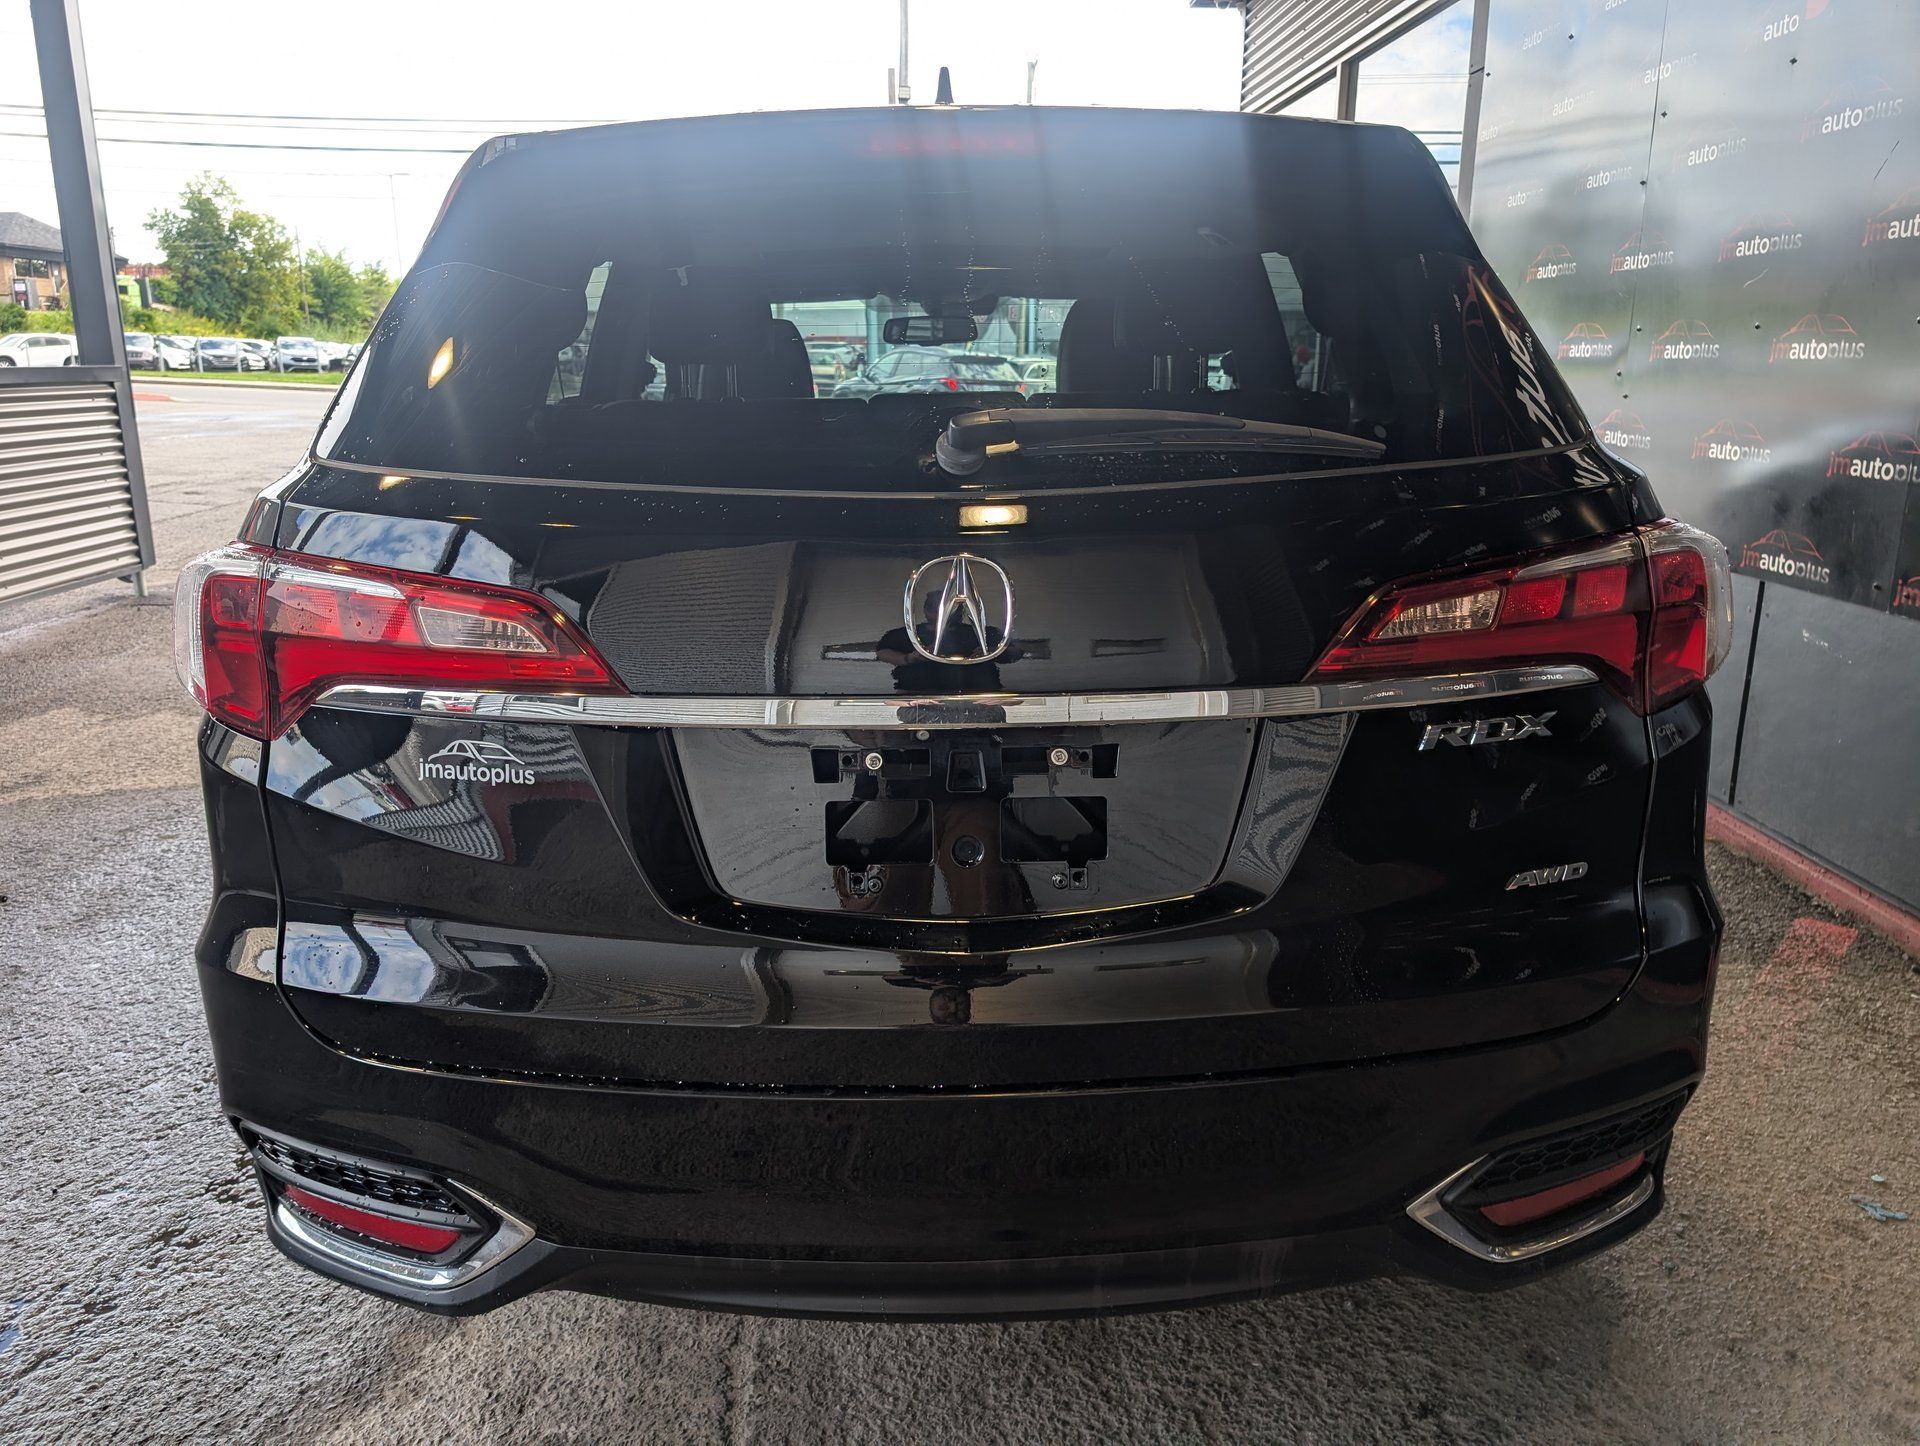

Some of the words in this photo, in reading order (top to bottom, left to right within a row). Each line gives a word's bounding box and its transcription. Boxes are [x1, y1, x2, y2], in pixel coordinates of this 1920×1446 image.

[1557, 341, 1613, 360] jmautoplus
[1648, 341, 1720, 362] jmautoplus
[1768, 338, 1865, 364] jmautoplus
[1740, 544, 1830, 583] jmautoplus
[1418, 710, 1558, 751] RDX
[418, 757, 535, 787] jmautoplus
[1505, 861, 1588, 891] AWD
